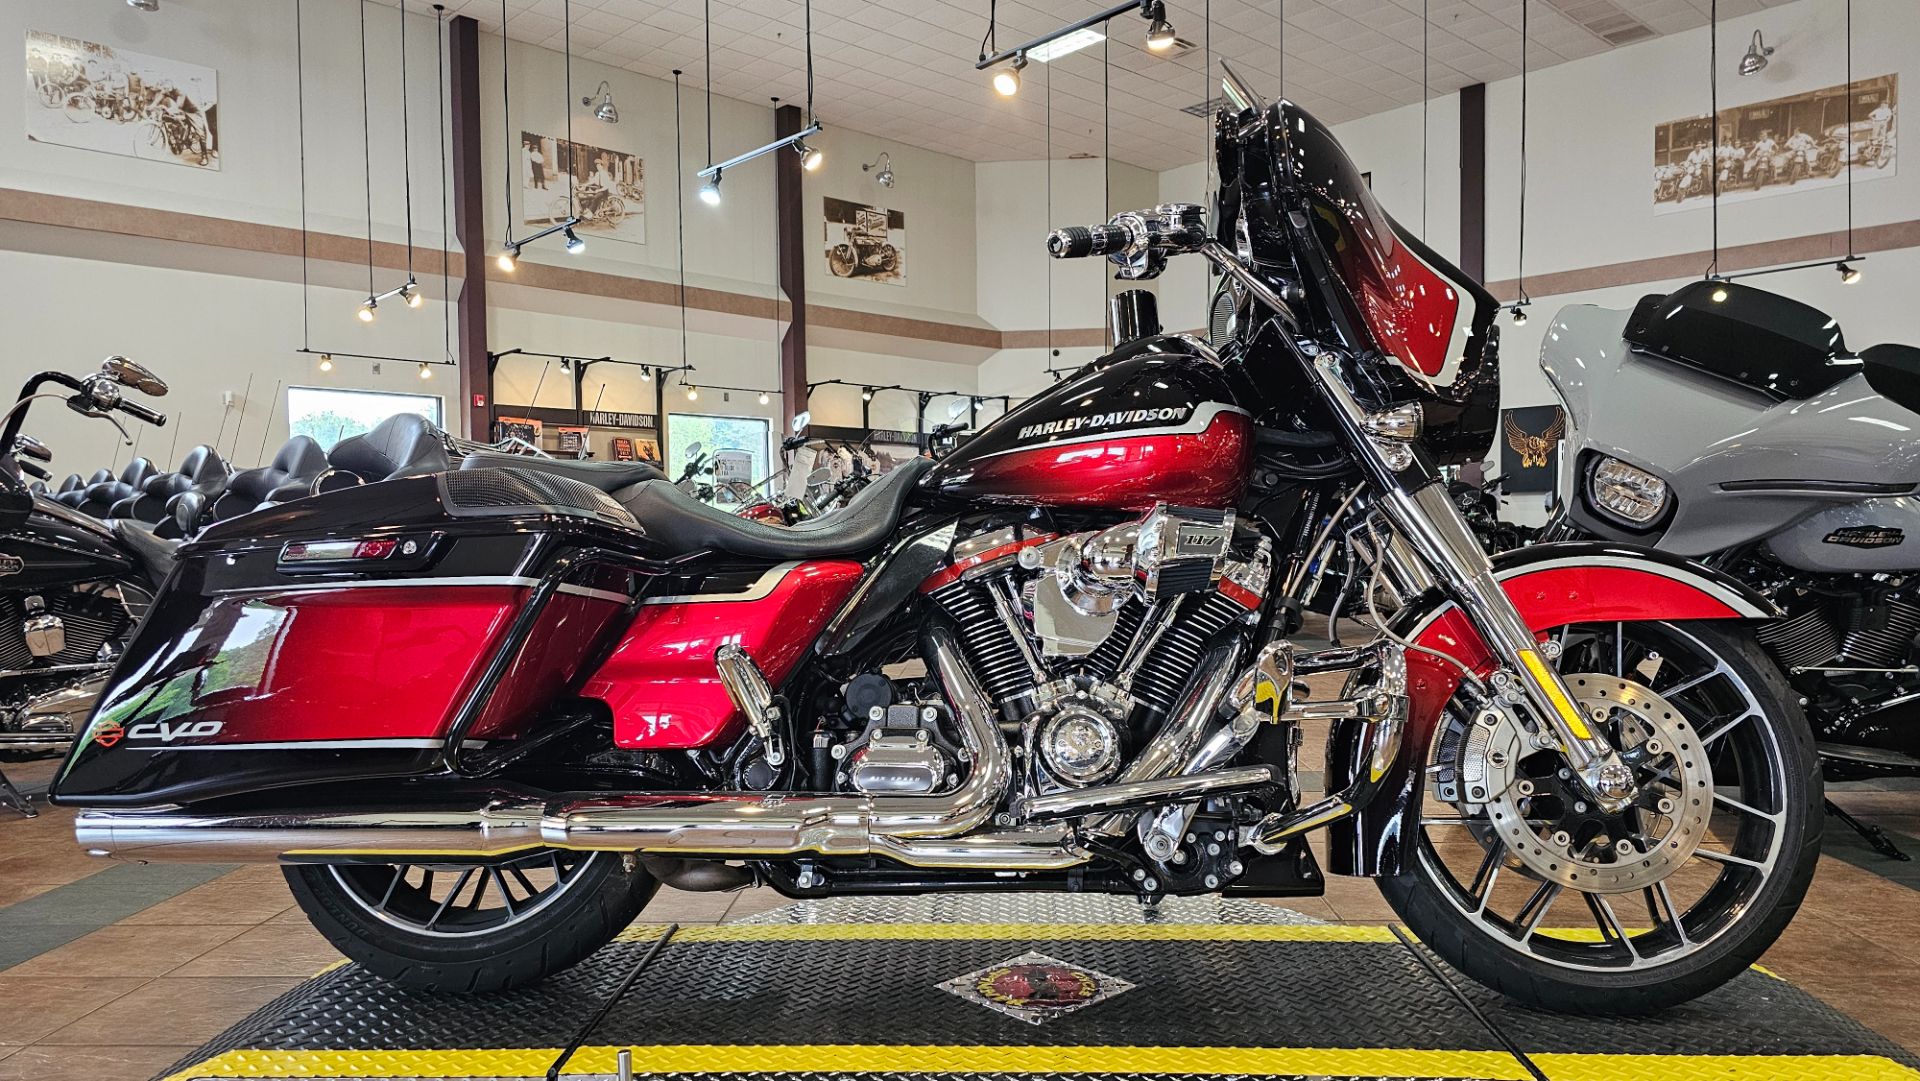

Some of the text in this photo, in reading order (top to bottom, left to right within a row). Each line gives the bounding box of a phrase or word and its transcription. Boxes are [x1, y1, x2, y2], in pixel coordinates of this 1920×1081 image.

[589, 411, 654, 428] HARLEY-DAVIDSON
[1017, 407, 1187, 440] HARLEY-DAVIDSON
[1184, 533, 1221, 546] 117
[127, 720, 224, 742] CVO
